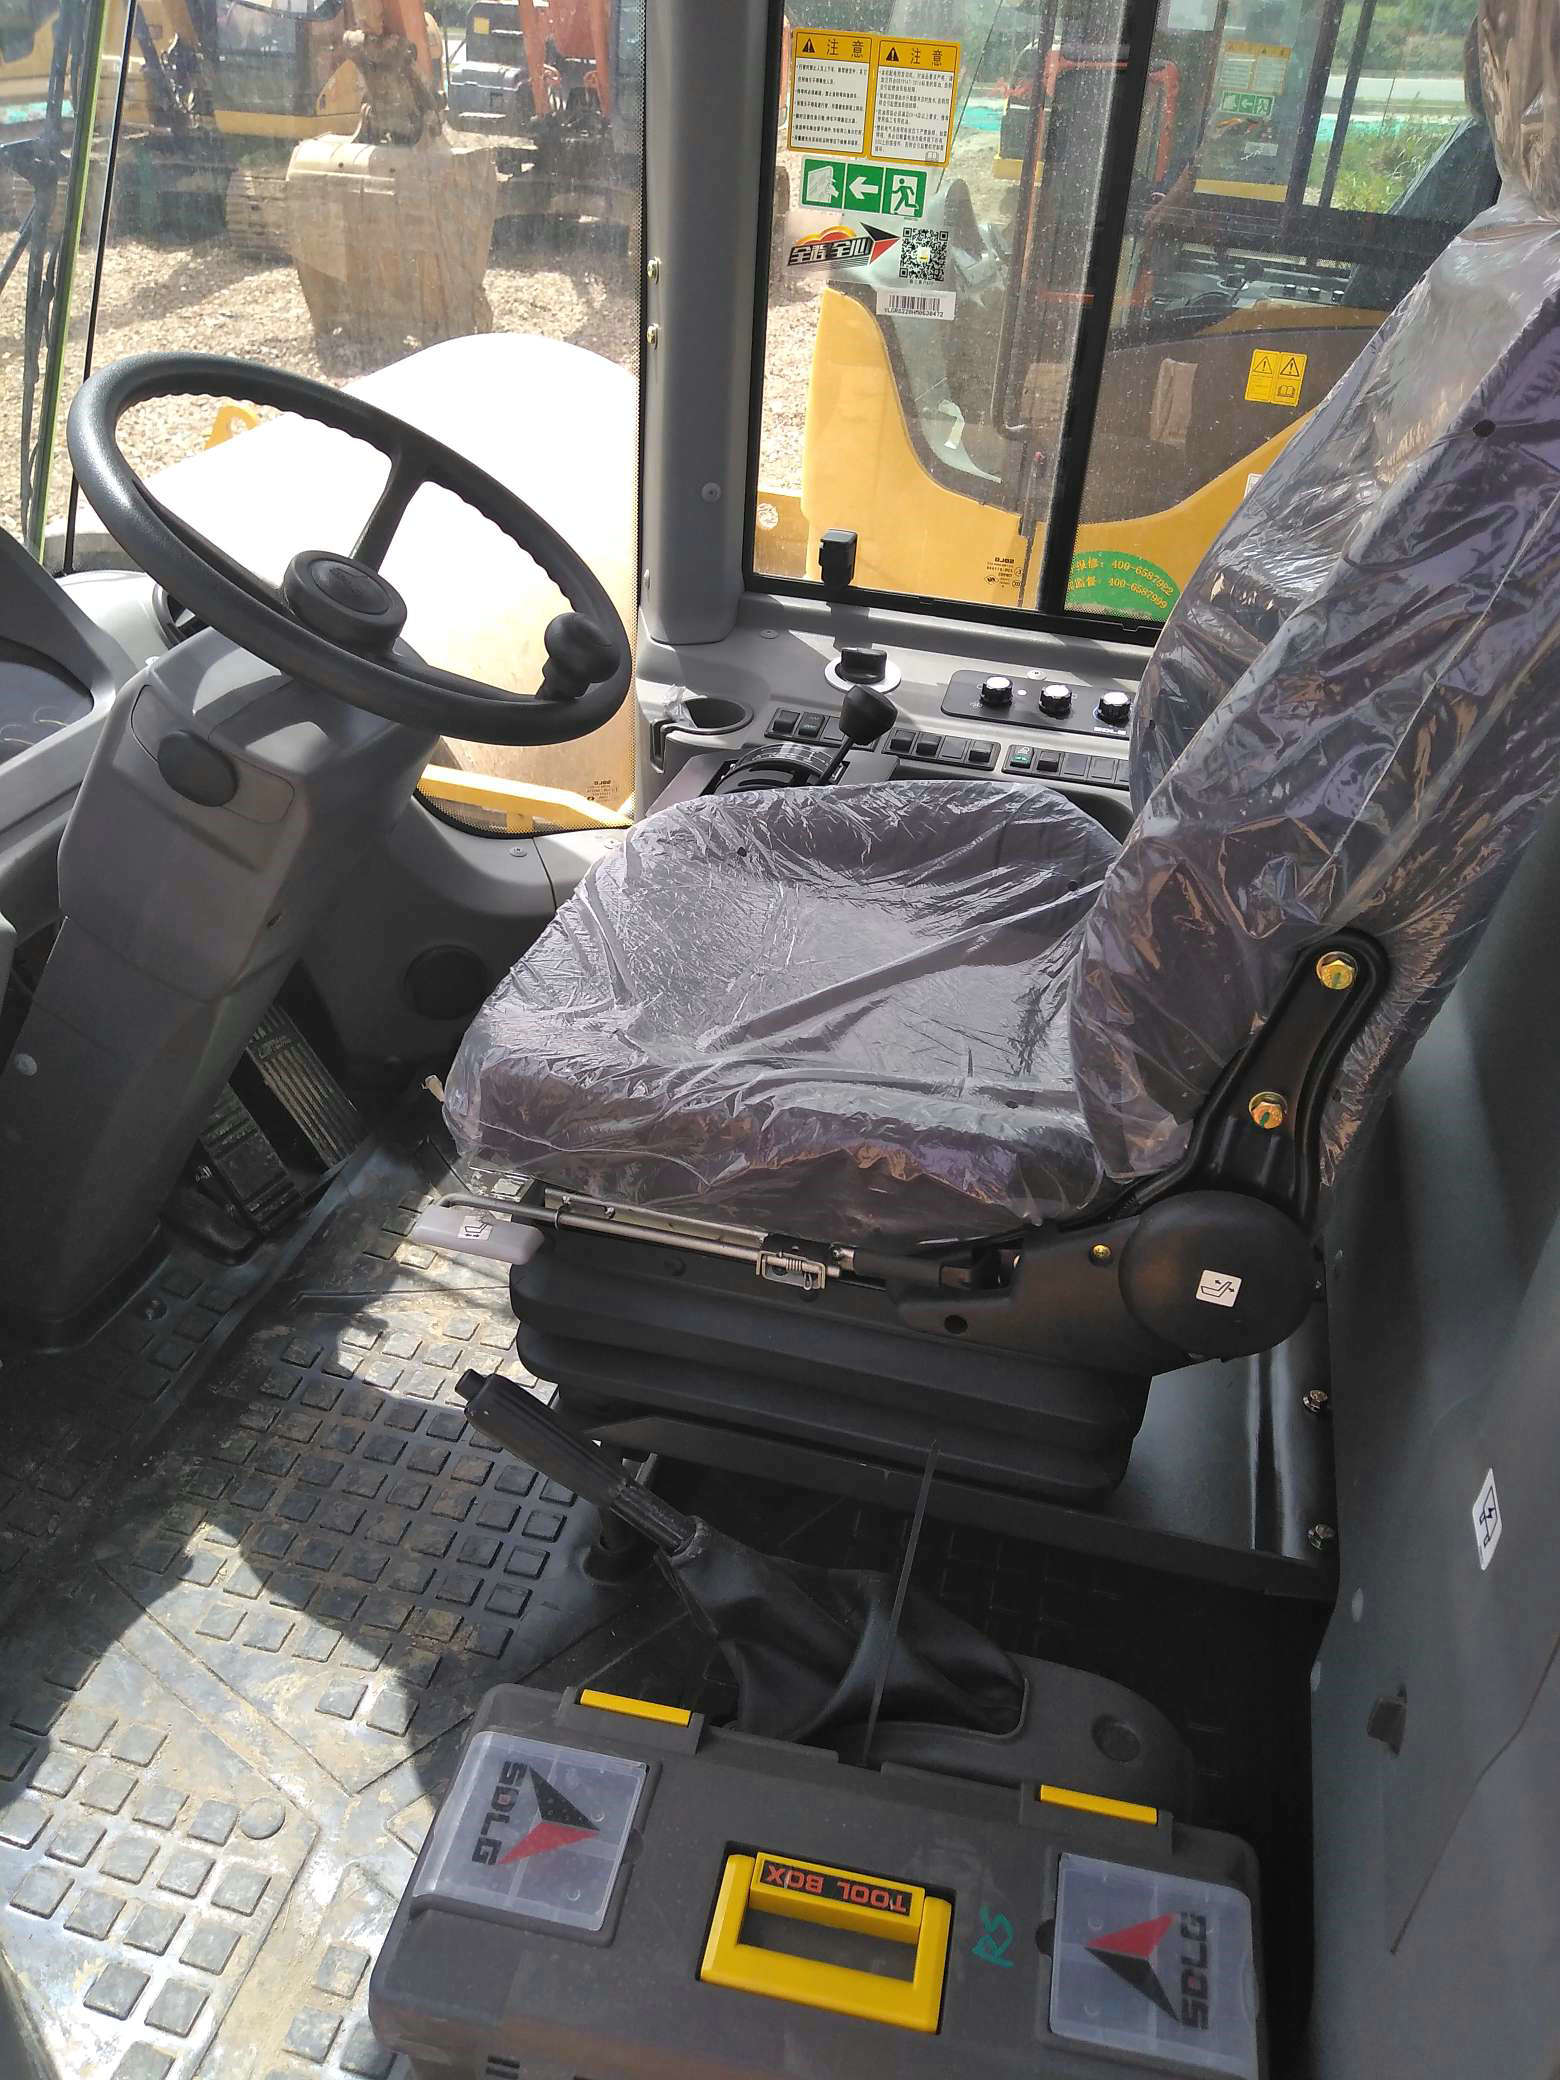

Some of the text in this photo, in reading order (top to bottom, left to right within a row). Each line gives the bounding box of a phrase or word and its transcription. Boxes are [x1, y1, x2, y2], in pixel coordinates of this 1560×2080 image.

[826, 38, 864, 58] 注意
[911, 47, 942, 67] 注意
[471, 1760, 528, 1866] SDLG
[766, 1863, 907, 1914] TOOL BOX
[1180, 1911, 1209, 2030] SDLG
